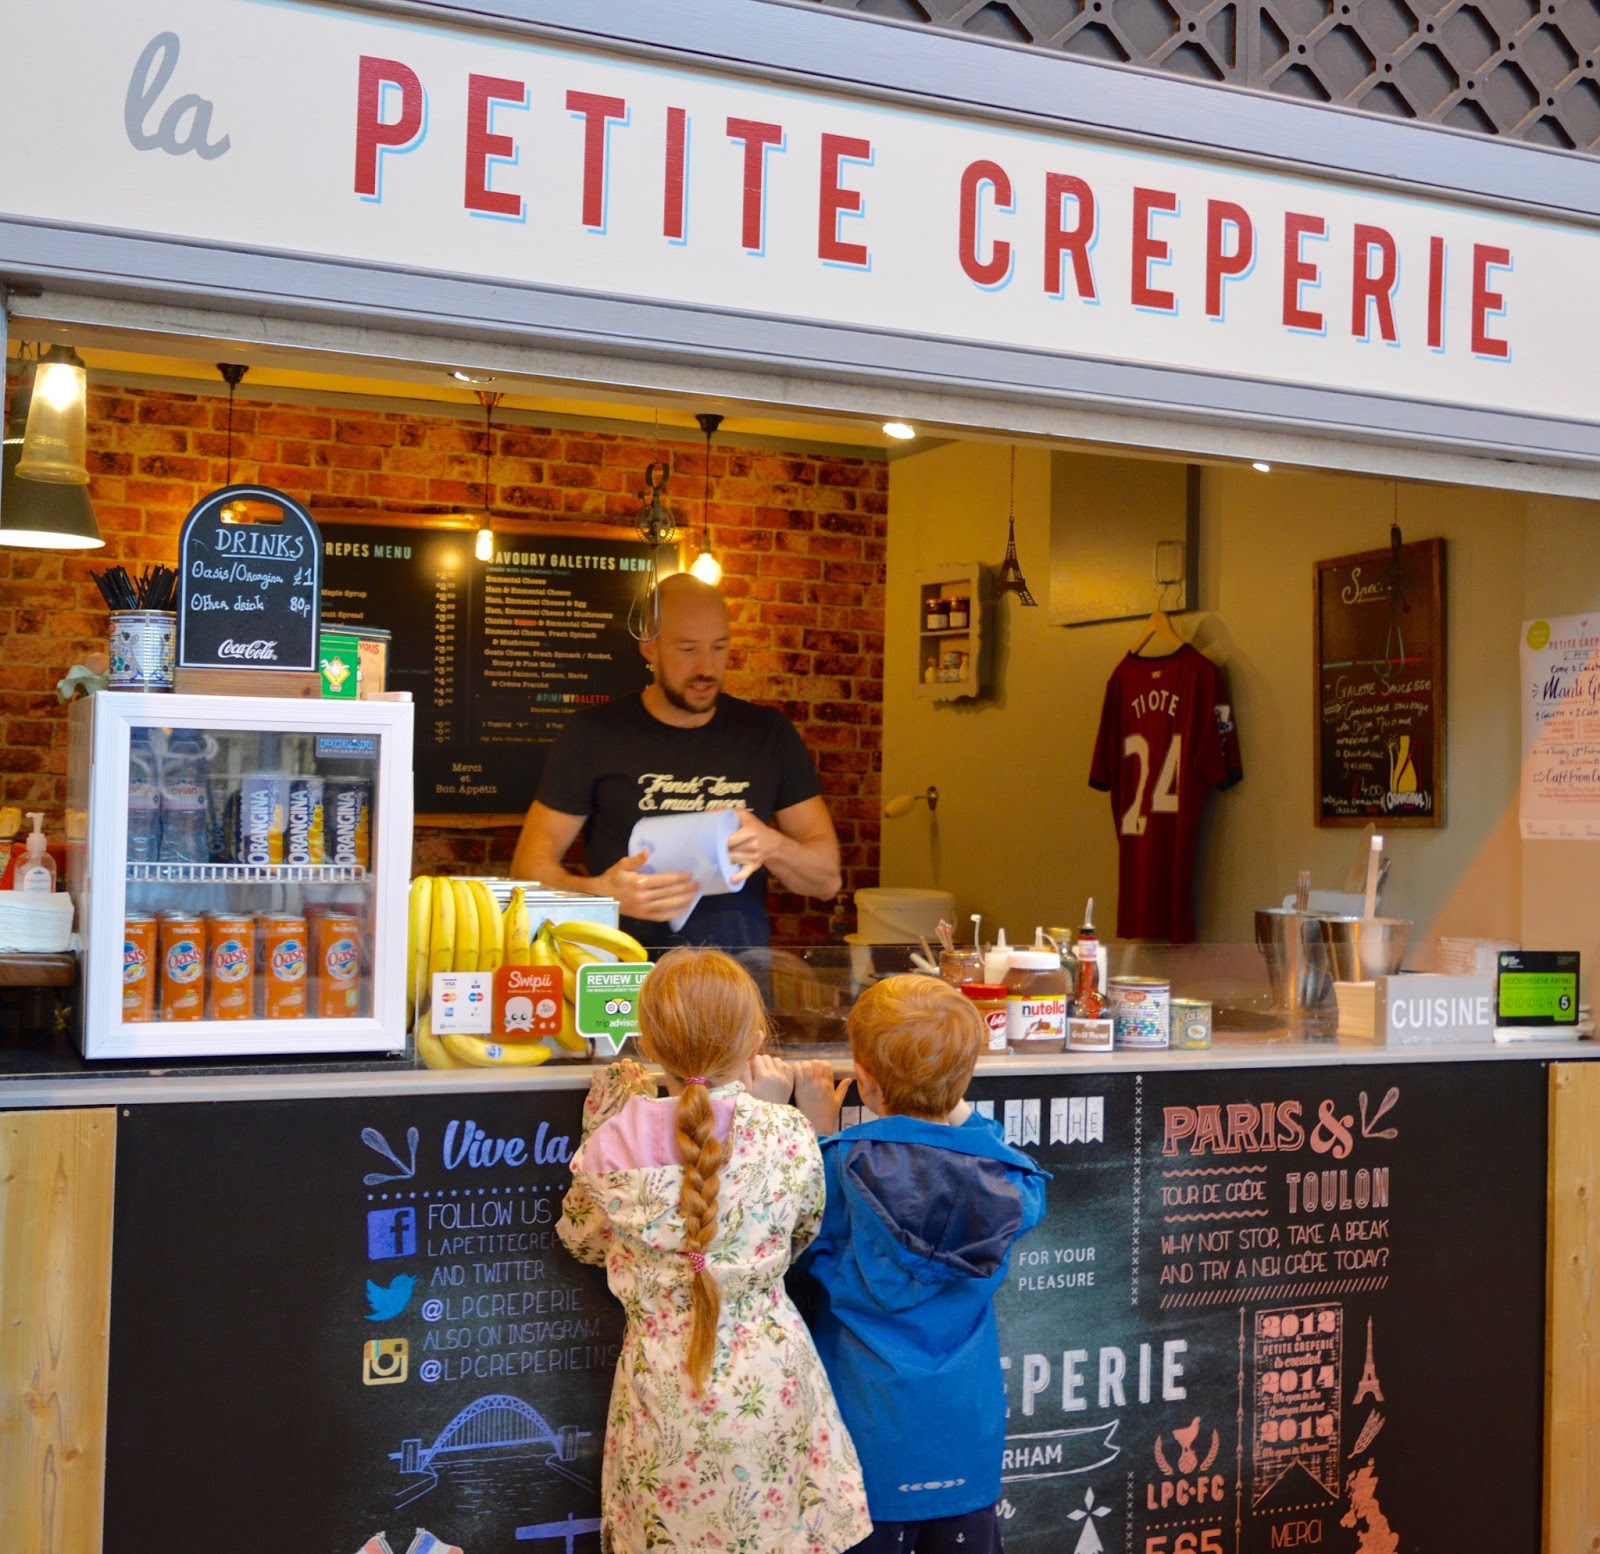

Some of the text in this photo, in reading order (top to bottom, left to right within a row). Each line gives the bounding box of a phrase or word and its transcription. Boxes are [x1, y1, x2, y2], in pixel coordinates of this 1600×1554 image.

[123, 31, 1512, 362] la PETITE CREPERIE
[215, 529, 304, 559] DRINKS
[323, 542, 411, 559] REPES MENU
[550, 554, 616, 570] GALETTES
[485, 575, 546, 585] Emmental Cheese
[511, 586, 545, 595] Emmental
[345, 590, 367, 598] Syrup
[505, 597, 539, 606] Emmental
[290, 597, 311, 617] 80p
[338, 611, 364, 619] Spread
[505, 607, 539, 616] Emmental
[541, 609, 565, 617] Cheese
[574, 610, 613, 619] Mushrooms
[485, 628, 520, 636] Emmental
[570, 631, 597, 639] Spinach
[546, 620, 580, 628] Emmental
[218, 639, 278, 660] Coca-Cola
[500, 639, 540, 647] Mushrooms
[533, 650, 552, 658] Fresh
[554, 651, 581, 659] Spinach
[484, 669, 511, 677] Smoked
[568, 672, 588, 680] Herbs
[1131, 690, 1179, 719] TIOTE
[320, 739, 373, 749] POLAR
[452, 763, 482, 772] Merci
[460, 775, 471, 783] et
[638, 773, 700, 793] French
[1121, 733, 1182, 836] 24
[171, 786, 198, 795] evian
[436, 785, 497, 795] Bon Appétit
[638, 793, 658, 810] &
[659, 794, 705, 811] much
[247, 790, 271, 866] ORANGINA
[288, 790, 311, 866] ORANGINA
[334, 791, 357, 866] ORANGINA
[168, 948, 201, 969] Oasis
[216, 948, 249, 968] Oasis
[508, 971, 552, 993] Swipii
[587, 975, 630, 985] REVIEW
[1022, 1001, 1064, 1016] nutella
[1560, 995, 1569, 1009] 5
[1391, 996, 1489, 1030] CUISINE
[1008, 1111, 1100, 1138] IN THE
[1162, 1099, 1354, 1159] PARIS &
[443, 1119, 572, 1170] Vive la
[1161, 1185, 1199, 1207] TOUR
[1203, 1183, 1219, 1203] DE
[1286, 1167, 1390, 1214] TOULON
[428, 1199, 552, 1230] FOLLOW US
[1161, 1219, 1390, 1255] WHY NOT STOP, TAKE A BREAK
[1019, 1248, 1095, 1266] FOR YOUR
[1159, 1263, 1194, 1286] AND
[1200, 1260, 1230, 1282] TRY
[1235, 1259, 1247, 1279] A
[1252, 1256, 1281, 1277] NEW
[1334, 1247, 1390, 1271] TODAY?
[430, 1260, 545, 1287] AND TWITTER
[1018, 1271, 1095, 1292] PLEASURE
[421, 1288, 583, 1322] @LPCREPERIE
[423, 1318, 600, 1351] ALSO ON INSTAGRAM
[1262, 1310, 1336, 1339] 2012
[1263, 1339, 1334, 1355] PETITE CREPERIE
[1000, 1339, 1188, 1419] PERIE
[1261, 1365, 1335, 1394] 2014
[1260, 1413, 1334, 1443] 2015
[1002, 1444, 1062, 1469] RHAM
[1271, 1519, 1323, 1550] MERCI
